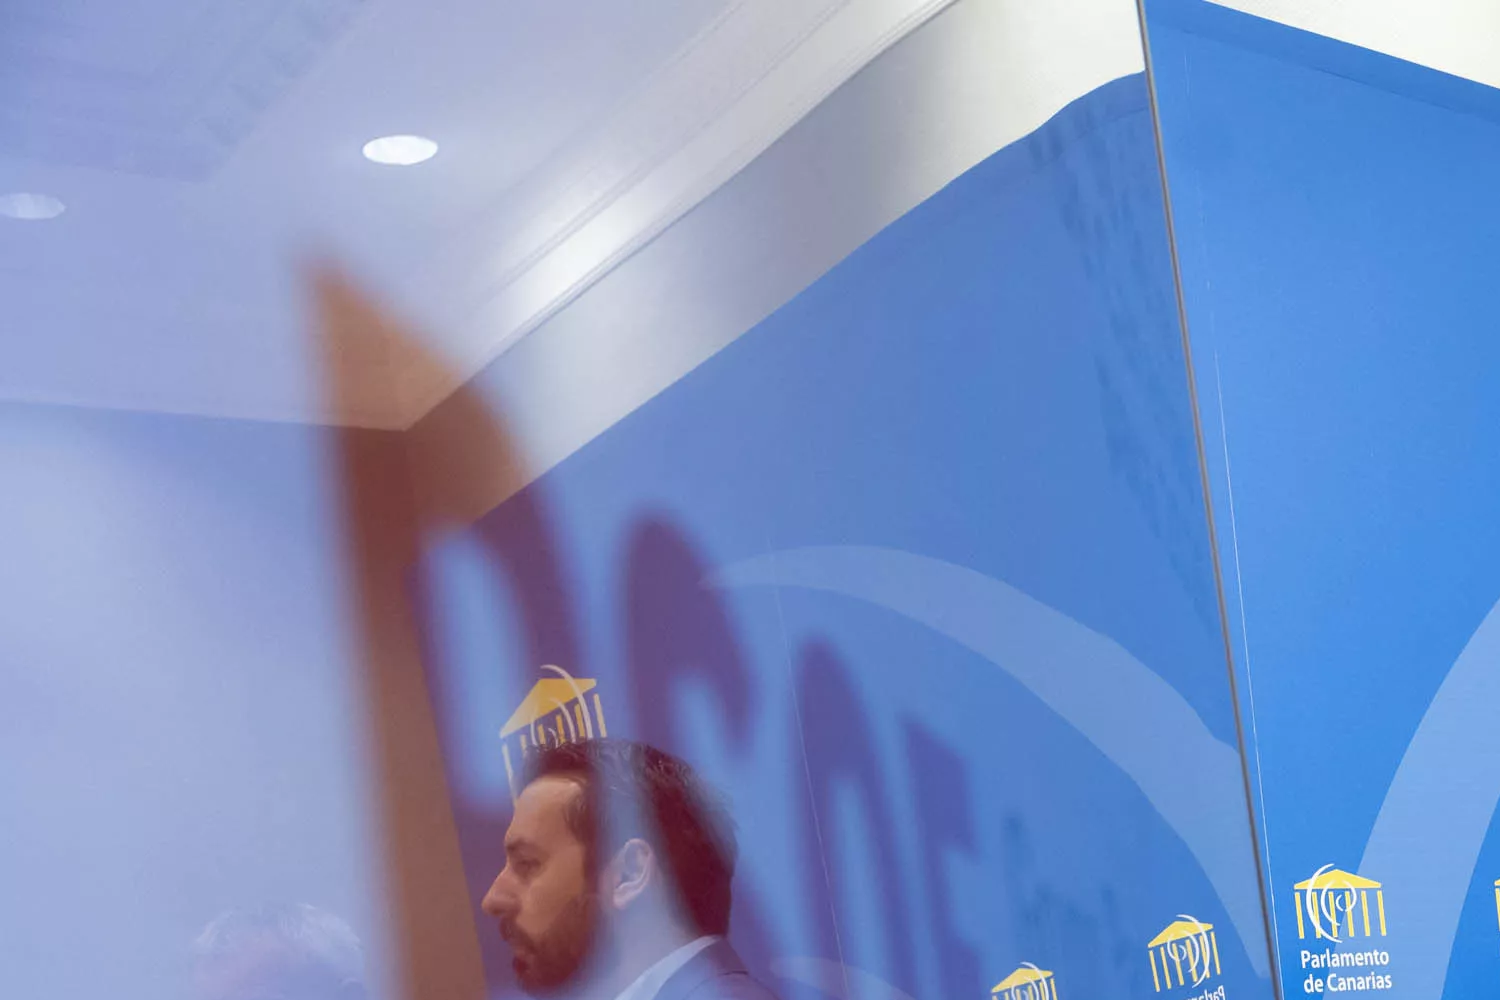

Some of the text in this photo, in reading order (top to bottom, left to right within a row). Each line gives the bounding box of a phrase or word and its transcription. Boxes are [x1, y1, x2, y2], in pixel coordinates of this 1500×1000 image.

[1300, 947, 1390, 969] Parlamento
[1303, 971, 1393, 994] de Canarias
